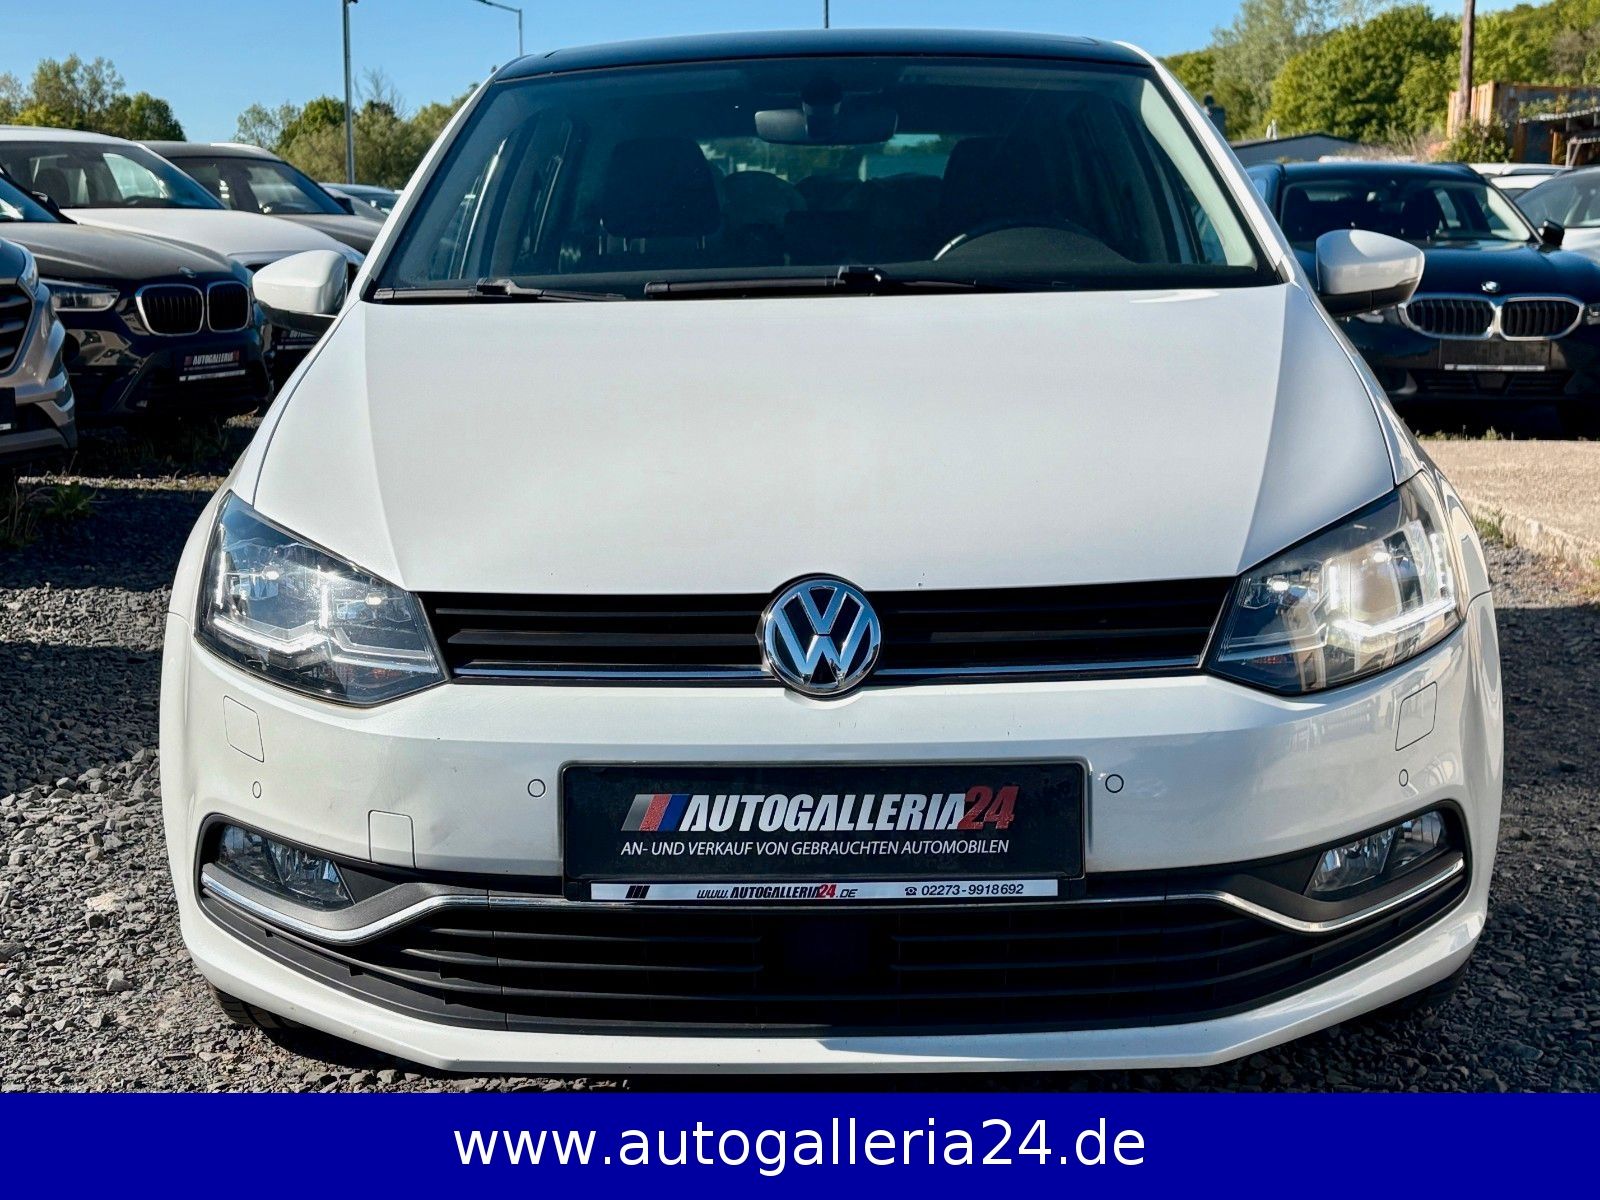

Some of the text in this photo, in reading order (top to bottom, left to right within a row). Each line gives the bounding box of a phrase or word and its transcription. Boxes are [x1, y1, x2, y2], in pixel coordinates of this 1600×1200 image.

[678, 785, 1020, 833] AUTOGALLERIA24
[620, 839, 1009, 856] AN- UND VERKAUF VON GEBRAUCHTEN AUTOMOBILEN
